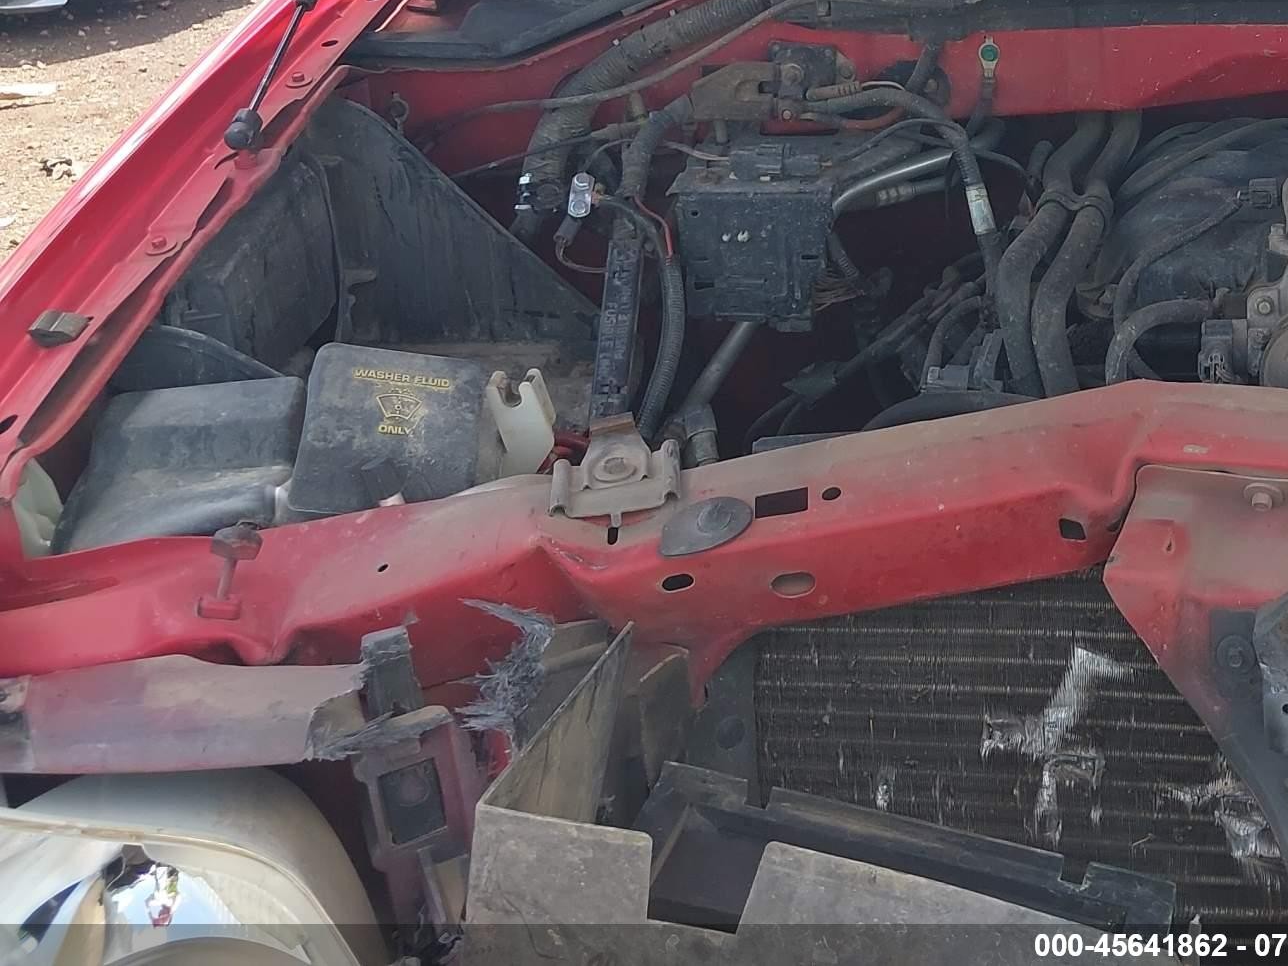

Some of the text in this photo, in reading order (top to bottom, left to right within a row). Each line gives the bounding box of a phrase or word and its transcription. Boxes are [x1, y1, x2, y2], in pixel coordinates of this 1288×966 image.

[355, 369, 449, 388] WASHER FLUID
[378, 424, 411, 435] ONLY
